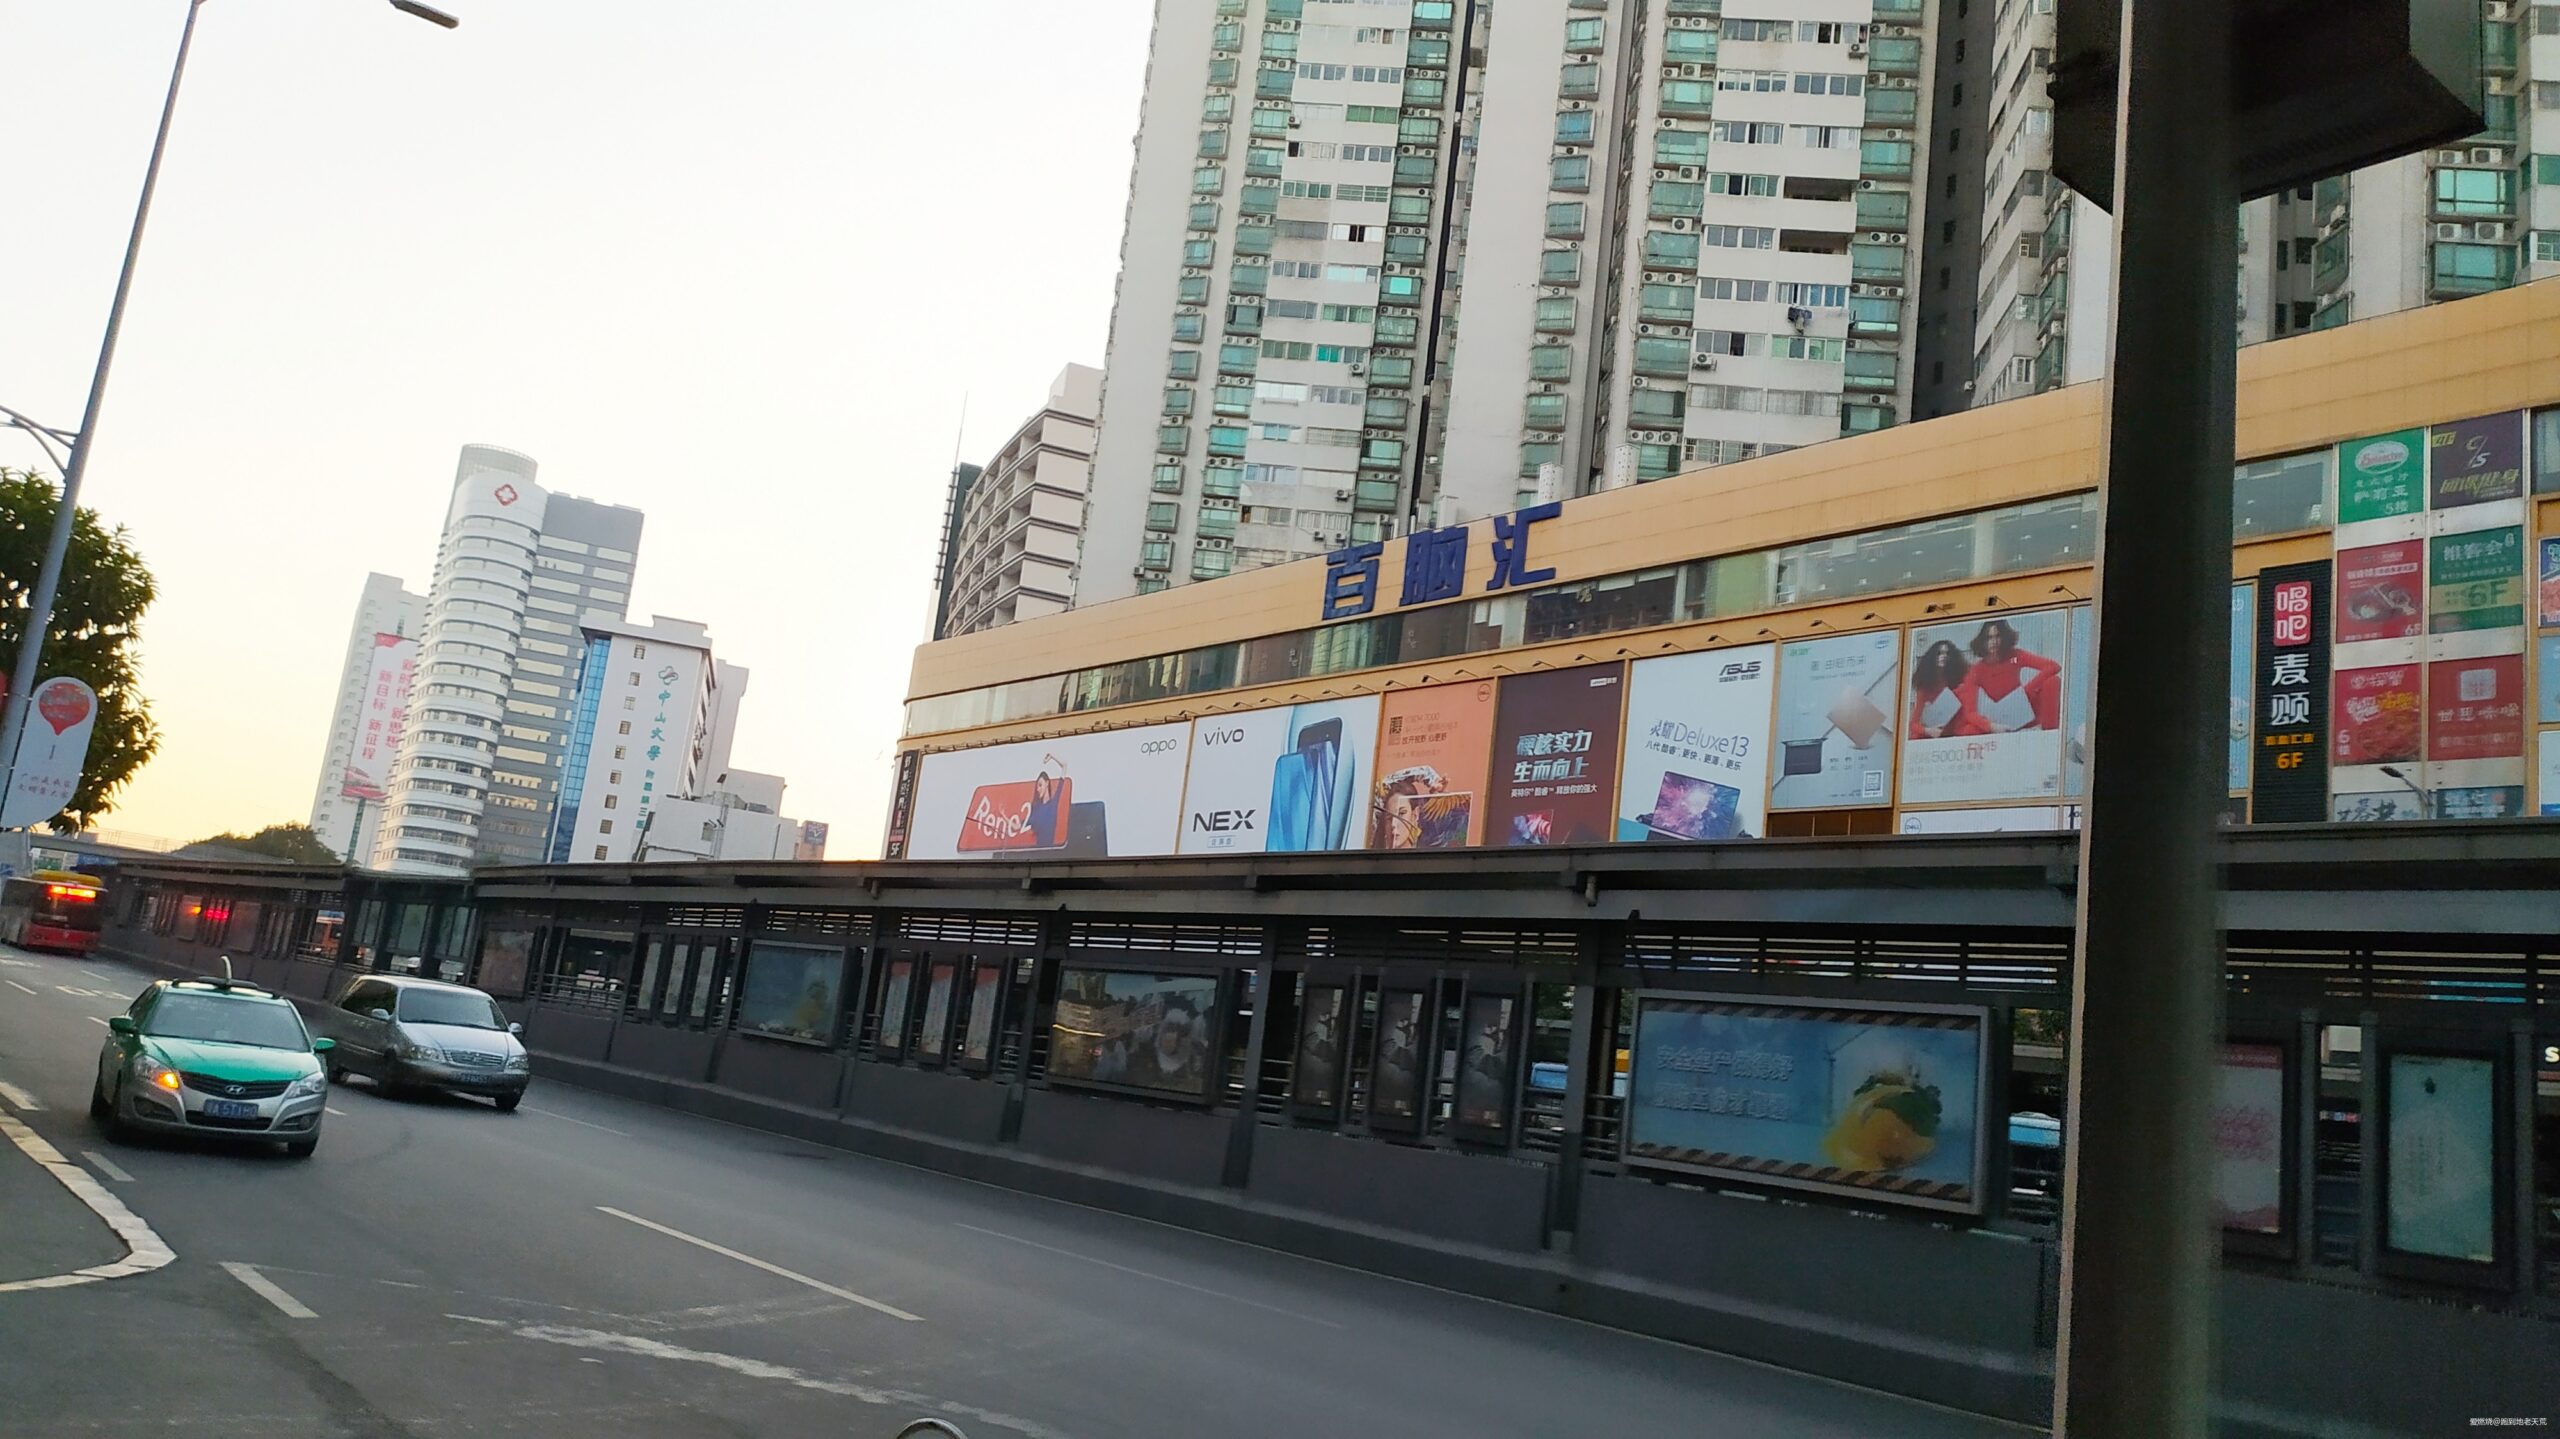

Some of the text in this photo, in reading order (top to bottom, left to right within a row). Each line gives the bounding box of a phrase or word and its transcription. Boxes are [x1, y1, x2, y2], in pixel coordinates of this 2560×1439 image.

[1322, 500, 1562, 621] 百脑汇
[2274, 584, 2309, 641] 唱吧
[1719, 661, 1762, 677] ASUS
[2271, 652, 2309, 726] 麦颂
[1513, 757, 1590, 784] 生而向上
[2277, 752, 2304, 769] 6F
[1193, 809, 1256, 832] NEX
